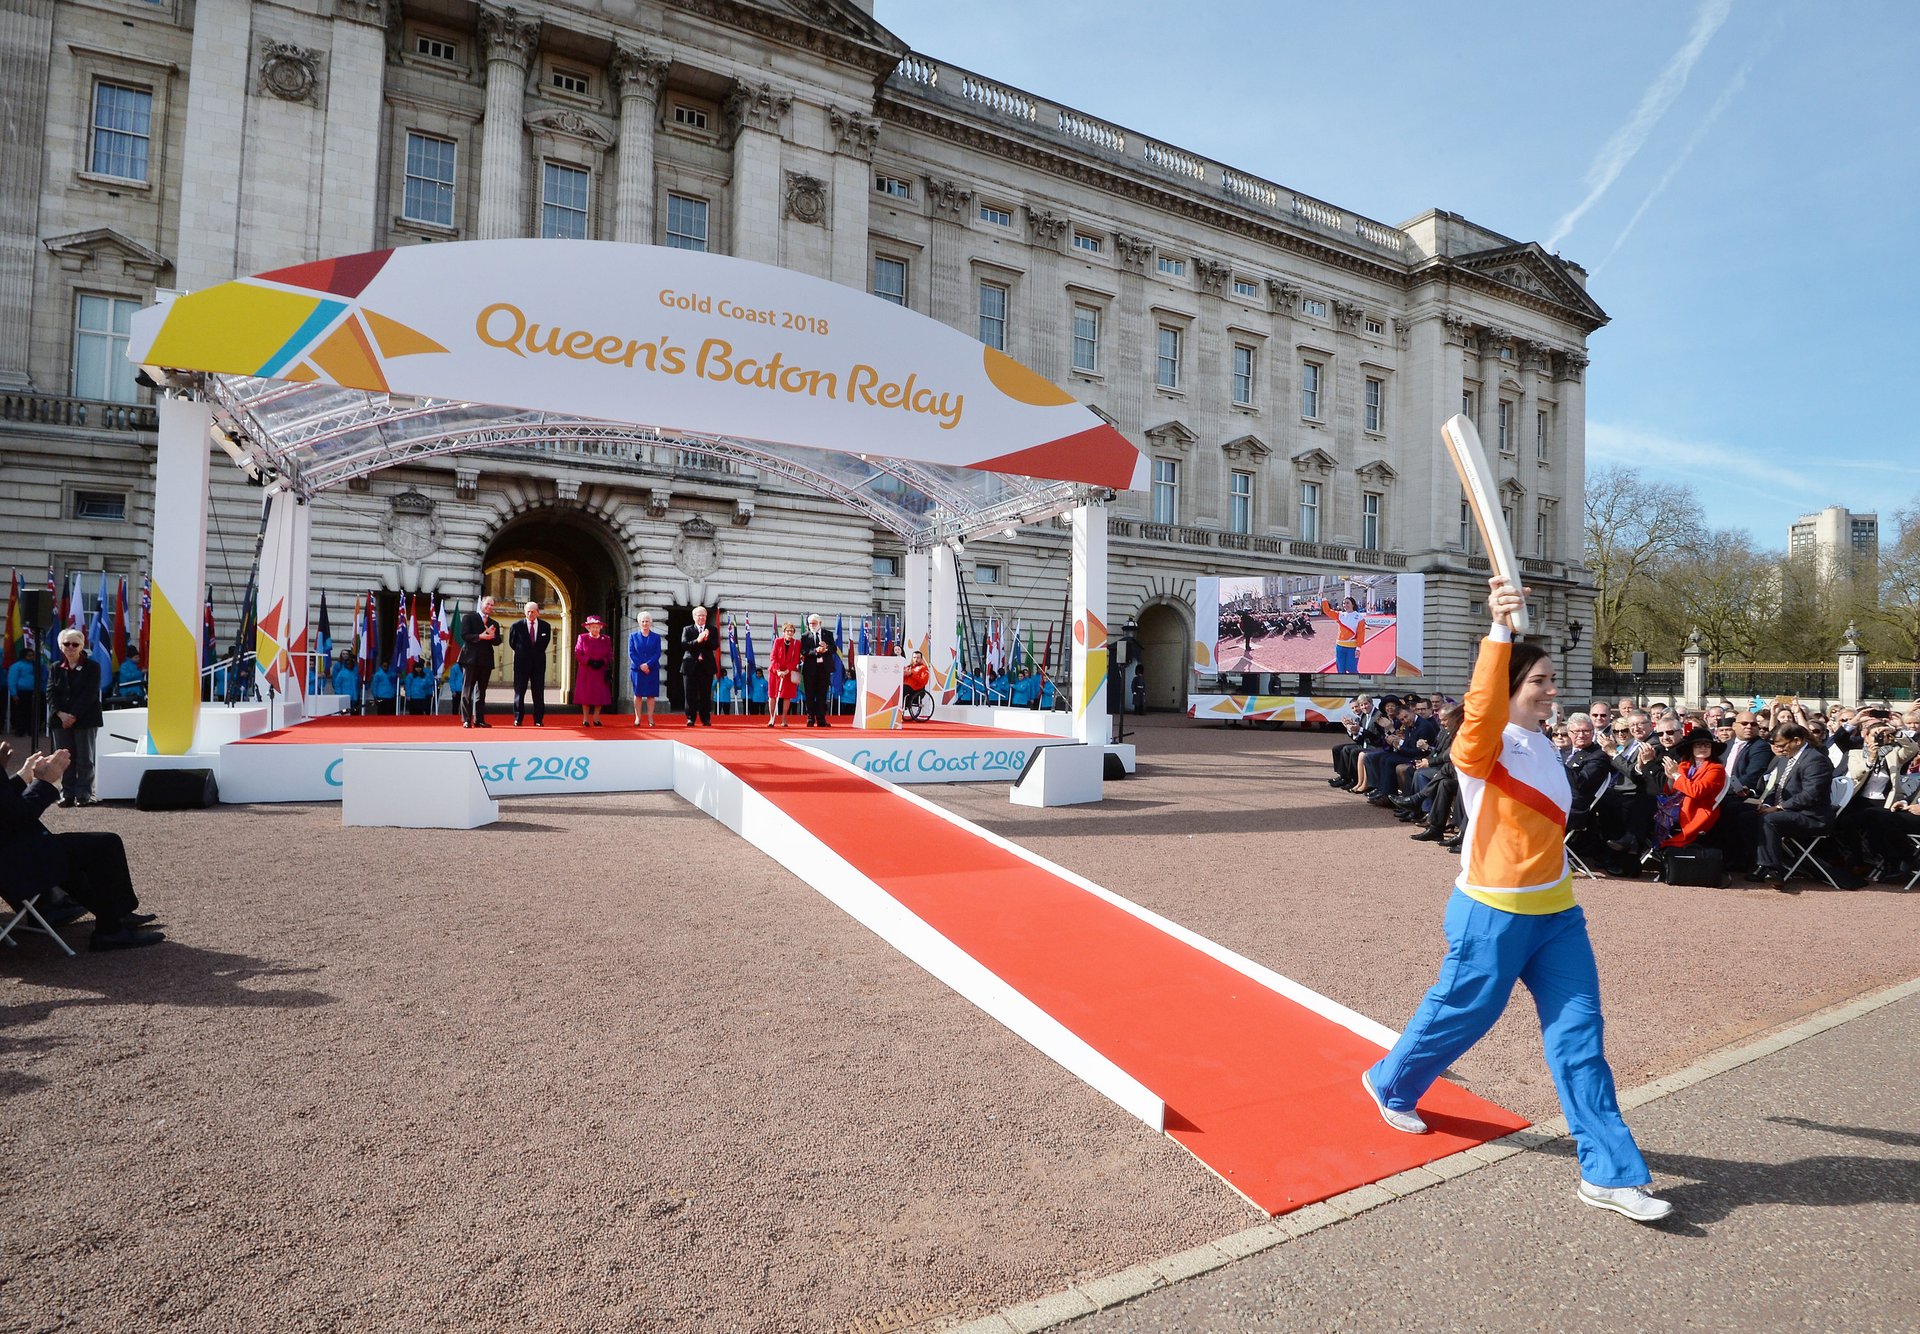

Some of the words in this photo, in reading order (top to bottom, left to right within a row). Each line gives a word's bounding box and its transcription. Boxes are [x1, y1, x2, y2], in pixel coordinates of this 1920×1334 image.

[660, 289, 711, 314] Gold
[717, 299, 776, 326] Coast
[782, 311, 830, 335] 2018
[476, 303, 686, 374] Queen's
[697, 339, 837, 400] Baton
[847, 365, 964, 430] Relay
[523, 755, 591, 783] 2018
[851, 749, 911, 773] Gold
[917, 749, 979, 773] Coast
[982, 750, 1026, 772] 2018
